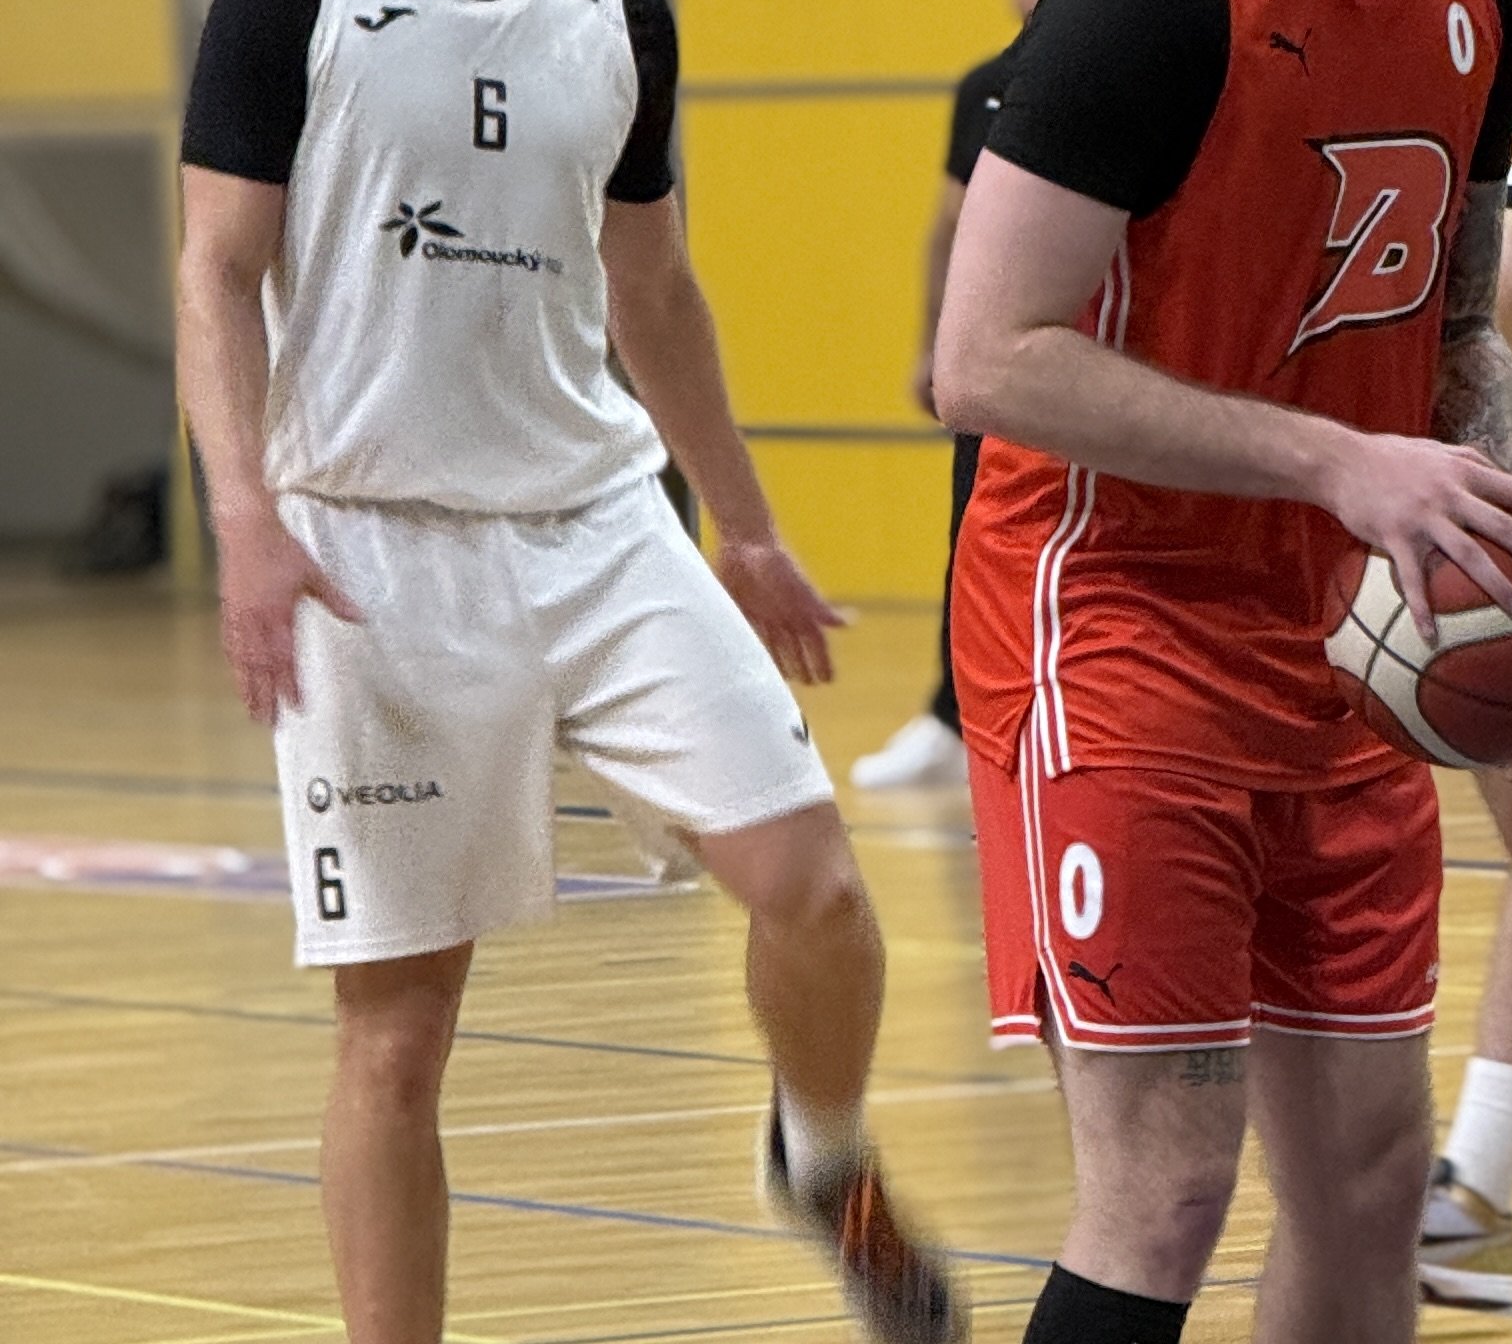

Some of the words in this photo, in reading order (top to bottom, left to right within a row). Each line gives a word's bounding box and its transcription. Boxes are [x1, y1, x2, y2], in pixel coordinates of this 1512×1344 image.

[1447, 1, 1476, 75] 0
[473, 77, 507, 152] 6
[336, 780, 443, 805] VEOLIA
[314, 846, 347, 921] 6
[1057, 841, 1105, 941] 0
